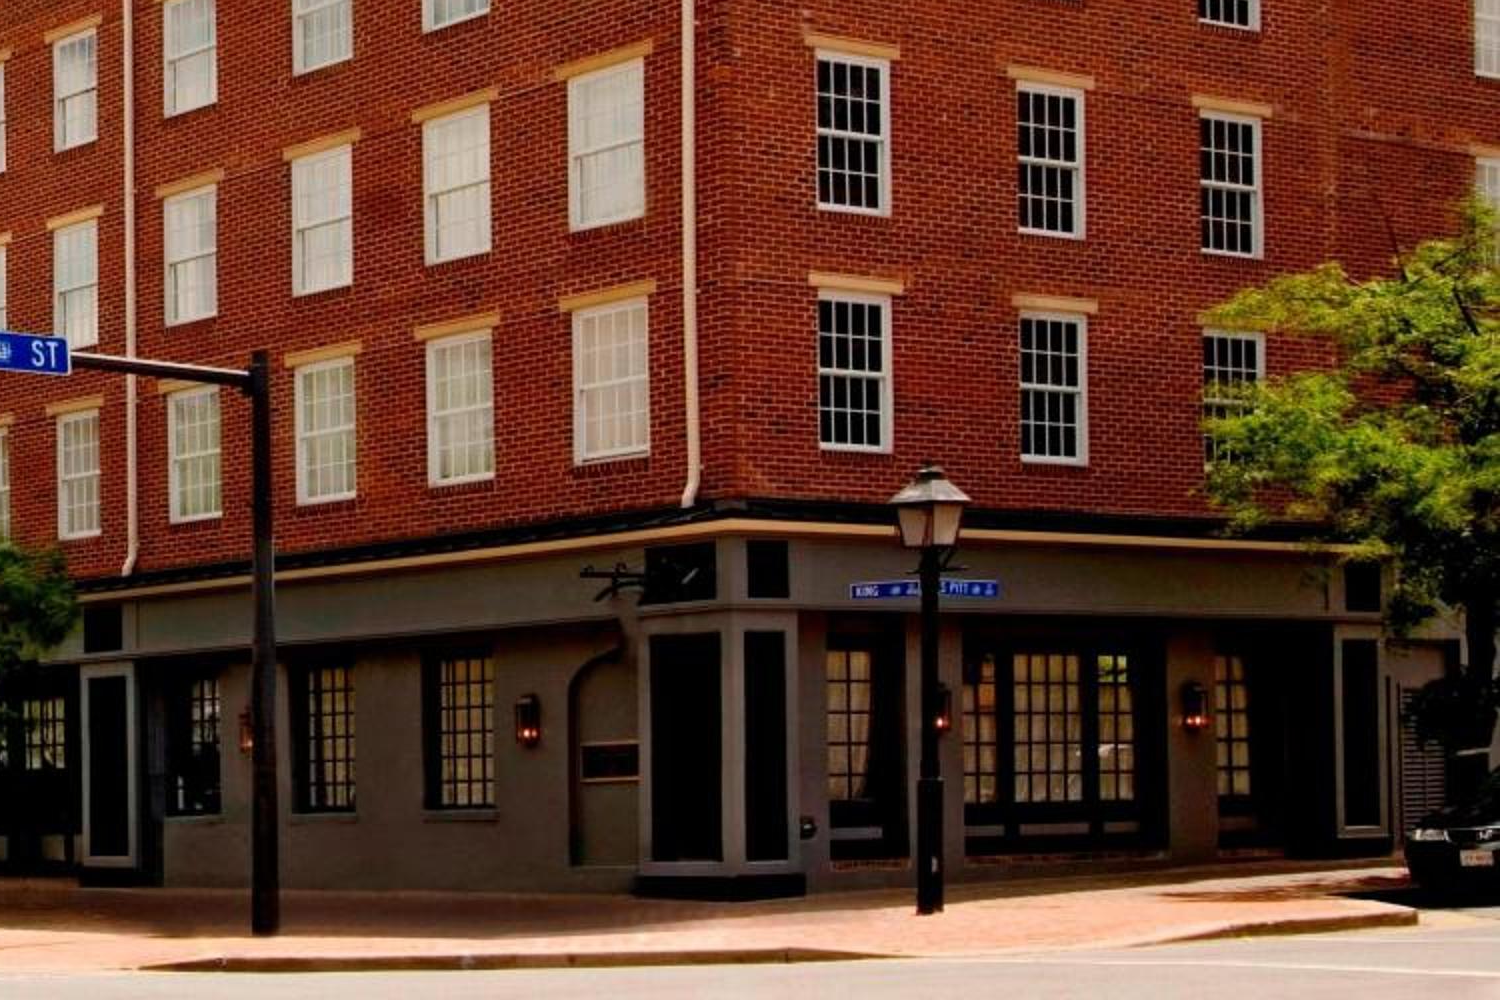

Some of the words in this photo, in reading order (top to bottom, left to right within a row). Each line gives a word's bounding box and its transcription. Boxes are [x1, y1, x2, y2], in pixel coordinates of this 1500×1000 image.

[31, 340, 59, 369] ST
[855, 585, 879, 597] KING
[950, 582, 969, 594] PITT
